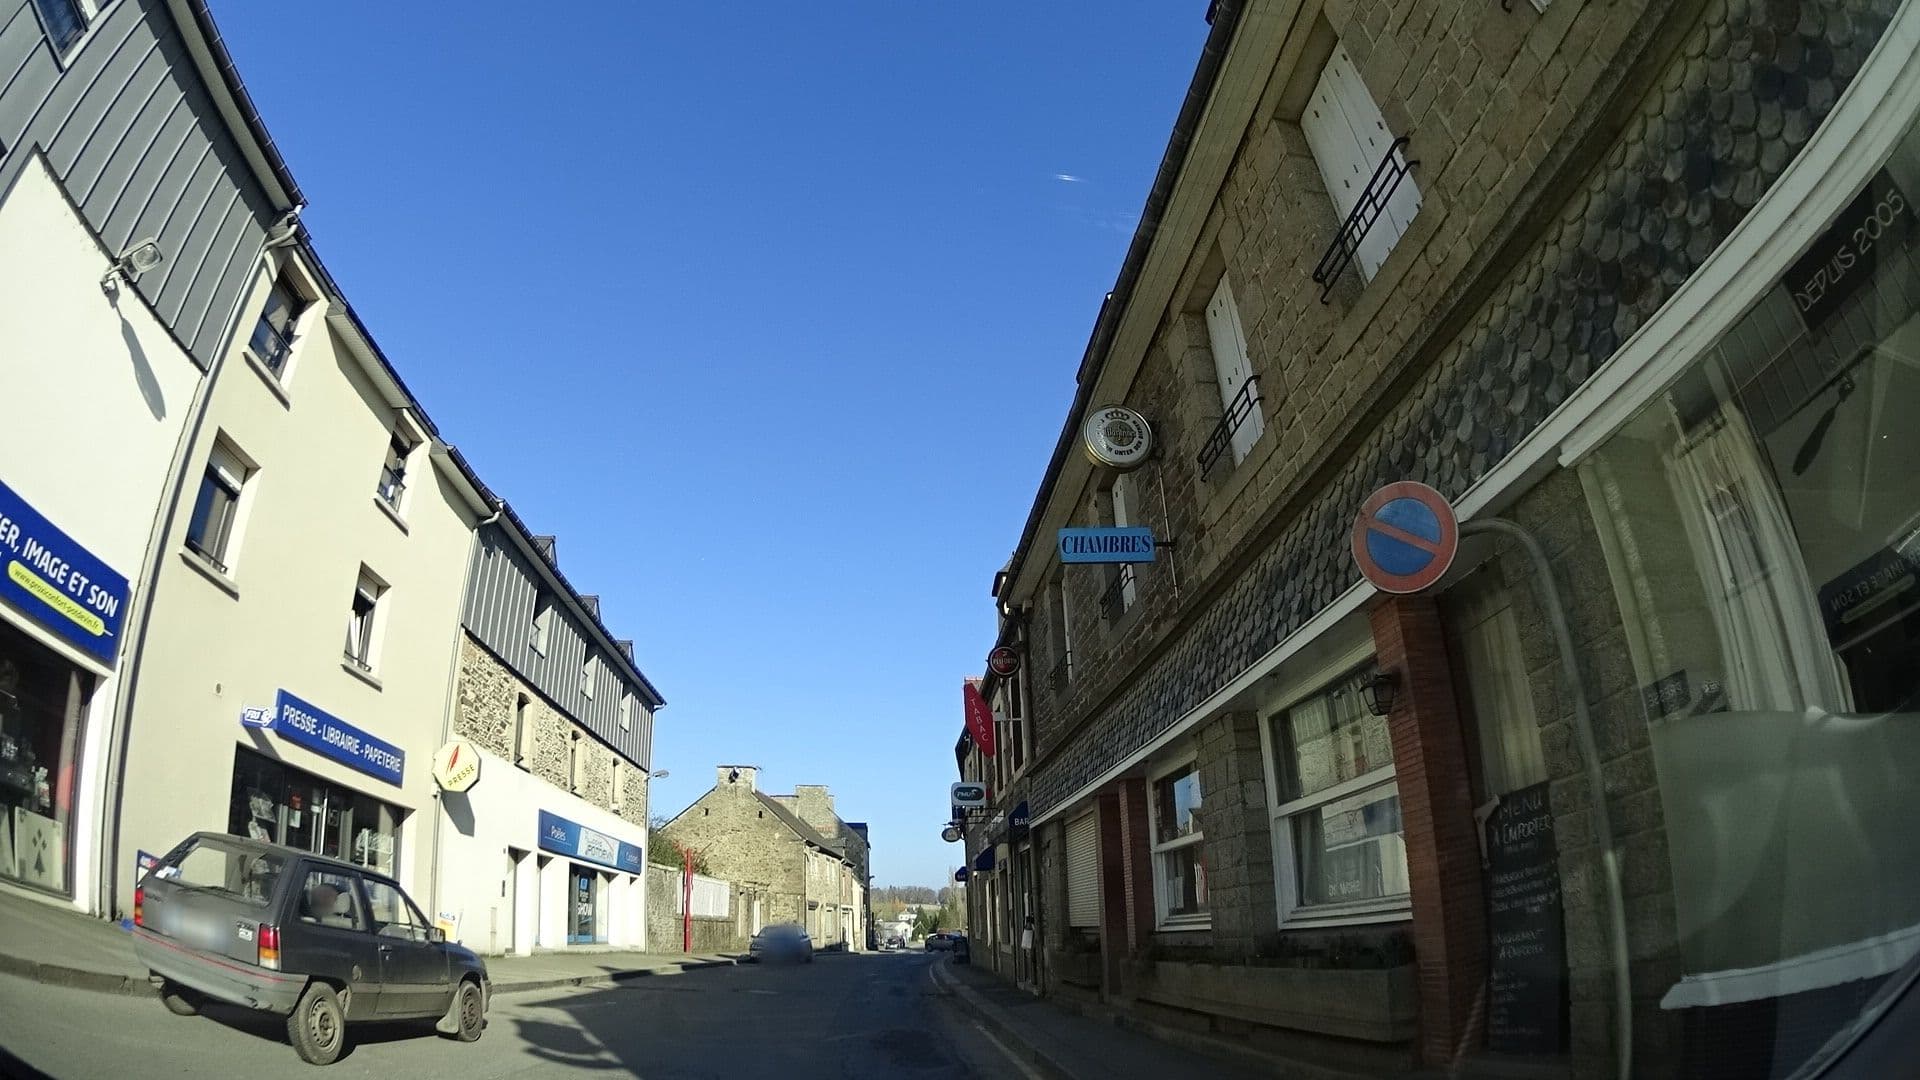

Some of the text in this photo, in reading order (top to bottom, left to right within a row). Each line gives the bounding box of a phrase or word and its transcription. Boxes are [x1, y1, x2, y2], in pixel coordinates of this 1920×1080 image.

[1793, 187, 1905, 313] DEPUIS 2005
[0, 512, 20, 553] ER,
[22, 537, 70, 585] IMAGE
[68, 570, 90, 598] ET
[86, 584, 119, 618] SON
[1061, 535, 1151, 555] CHAMBRES
[282, 704, 317, 735] PRESSE
[322, 723, 361, 756] LIBRAIRIE
[363, 746, 402, 773] PAPETERIE
[969, 697, 989, 742] TABAC
[447, 763, 475, 787] PRESSE
[1014, 817, 1030, 827] BAR
